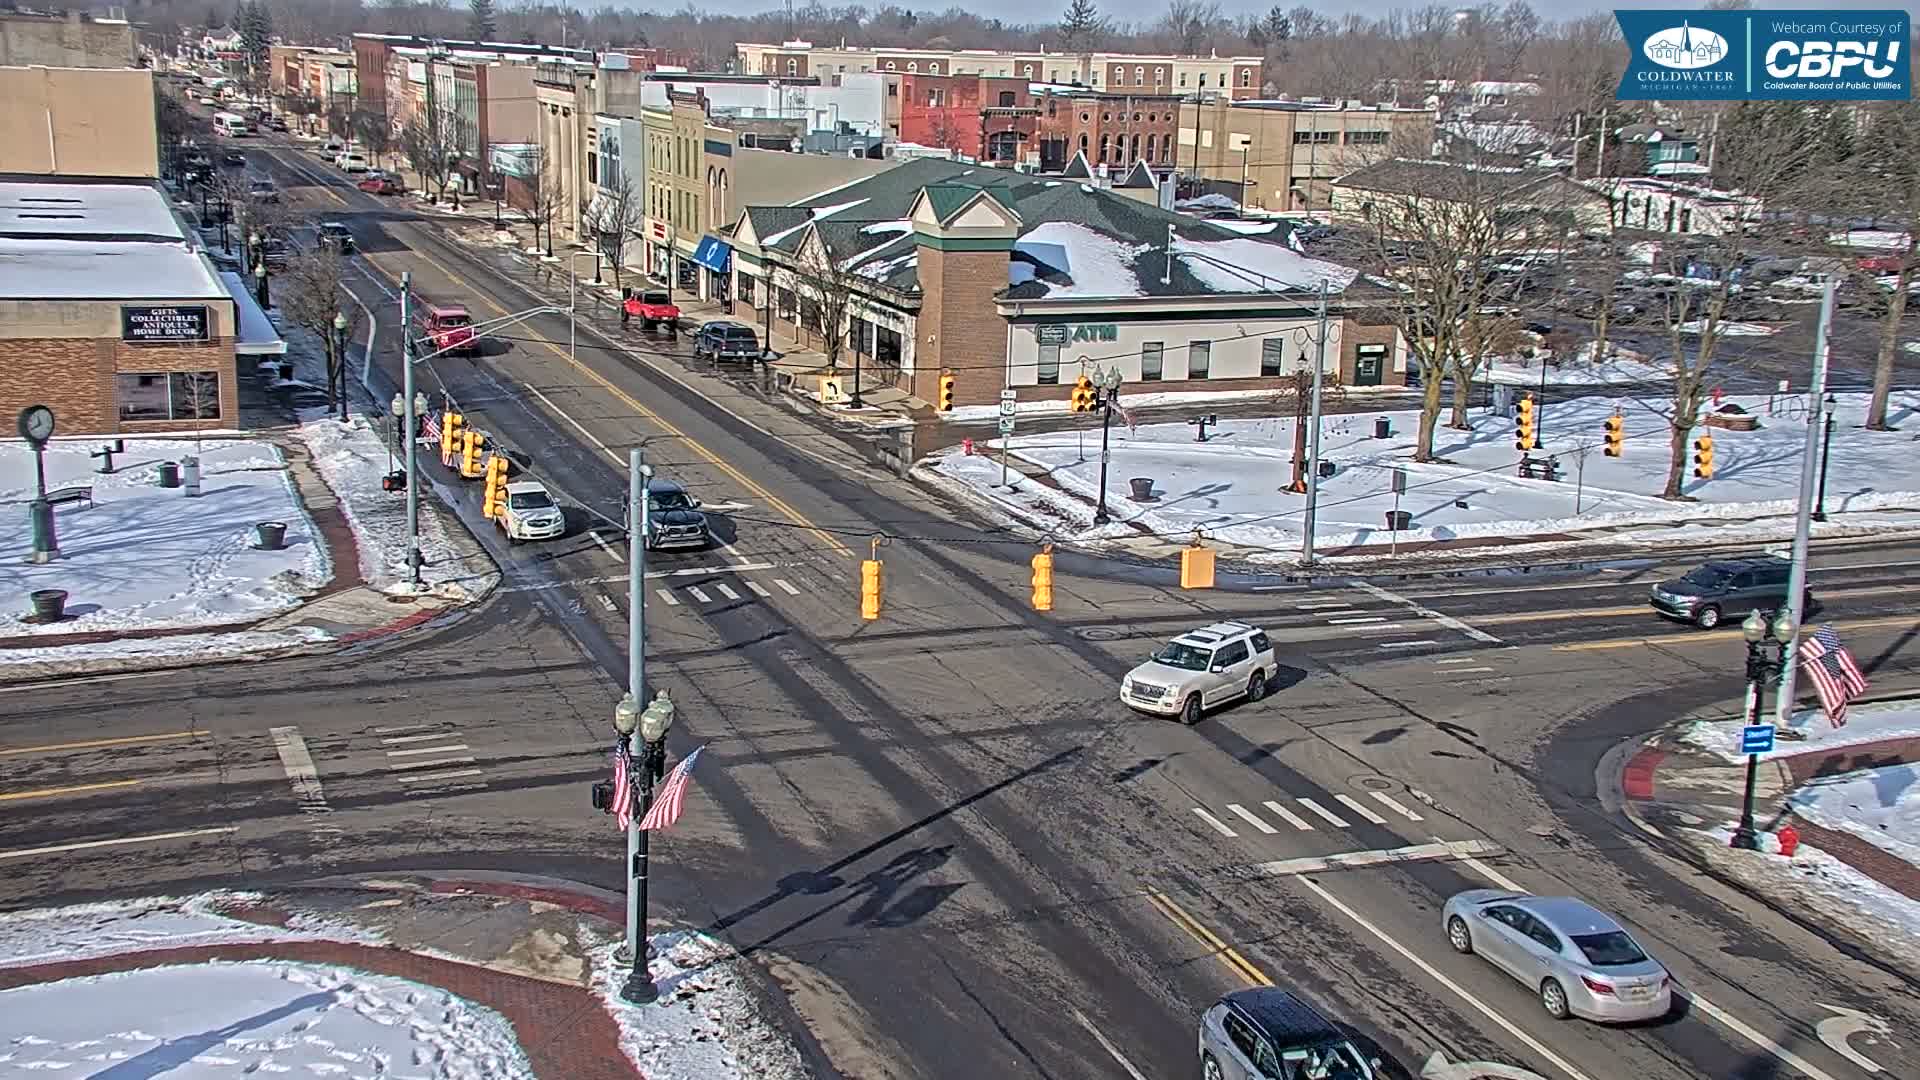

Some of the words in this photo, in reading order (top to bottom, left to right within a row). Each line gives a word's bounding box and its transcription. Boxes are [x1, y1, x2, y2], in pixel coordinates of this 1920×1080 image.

[151, 308, 178, 316] GIFTS
[142, 321, 189, 329] ANTIQUES
[1072, 325, 1118, 343] ATM
[1004, 402, 1013, 412] 12
